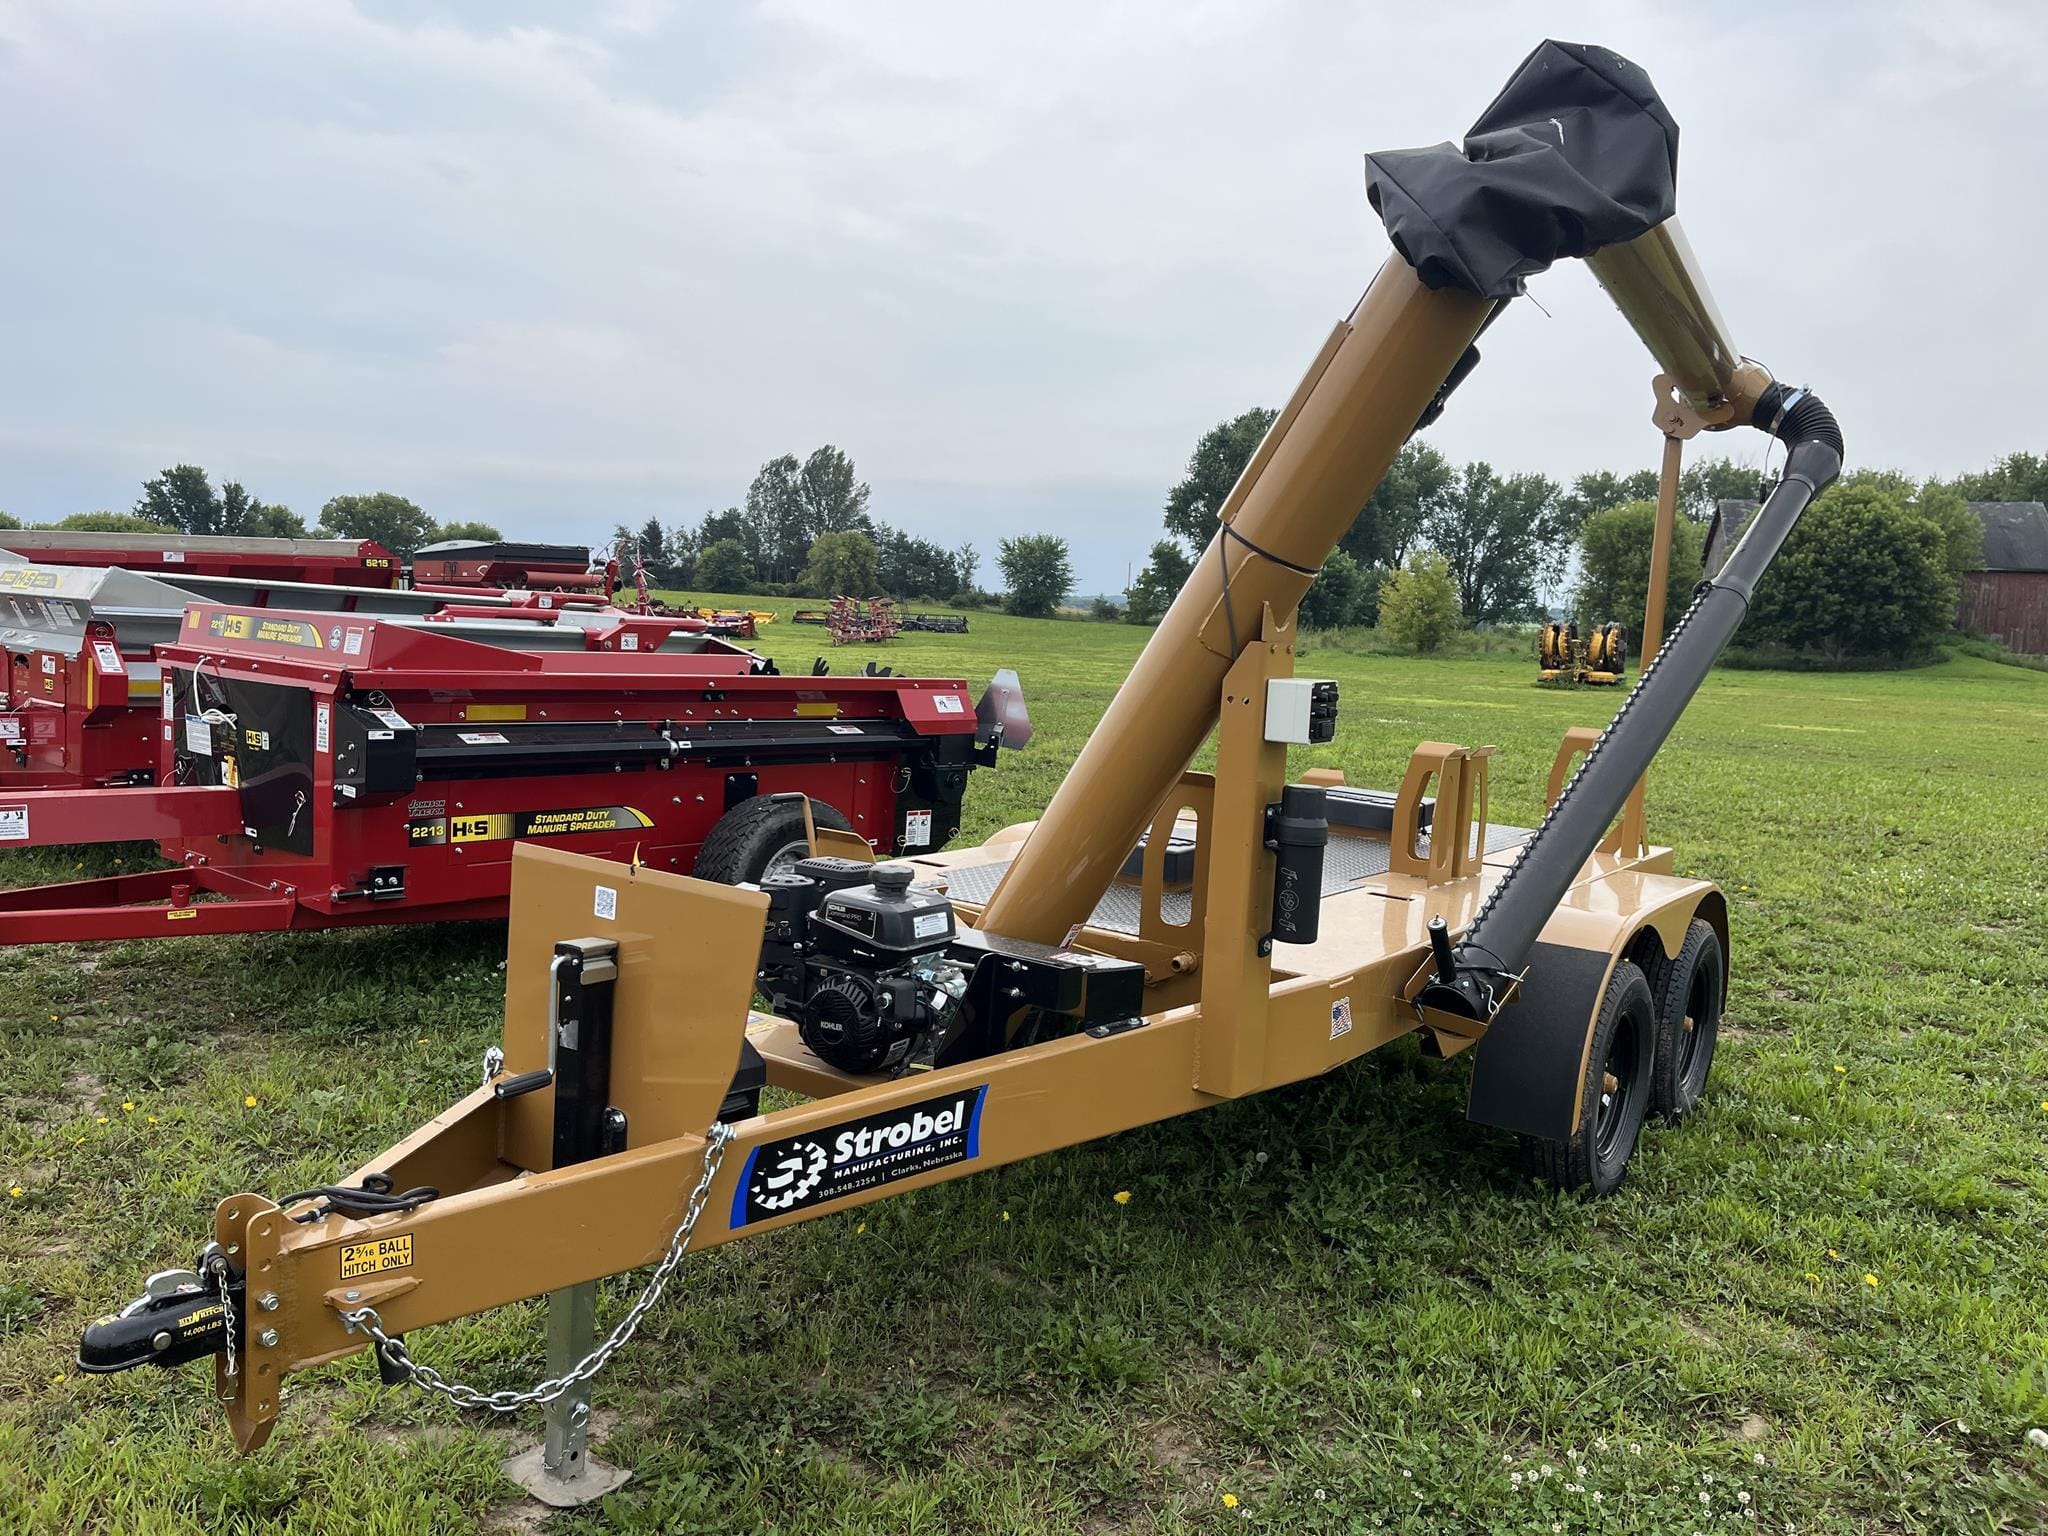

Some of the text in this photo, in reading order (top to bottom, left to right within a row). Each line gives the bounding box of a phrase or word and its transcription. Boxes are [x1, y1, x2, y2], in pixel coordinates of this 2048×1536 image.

[408, 799, 446, 809] JOHNSON
[408, 807, 445, 817] TRACTOR
[535, 810, 610, 824] STANDARD DUTY
[412, 825, 444, 838] 2213
[452, 820, 489, 838] H&S
[527, 820, 616, 835] MANURE SPREADER
[820, 1020, 843, 1031] KOHLER
[833, 1100, 965, 1164] Strobel
[834, 1136, 963, 1179] MANUFACTURING, INC.
[891, 1150, 963, 1177] Clarks, Nebraska
[818, 1175, 876, 1198] 308.548.2254
[379, 1238, 410, 1255] BALL
[343, 1253, 410, 1276] HITCH ONLY
[183, 1319, 222, 1338] 14,000 LBS
